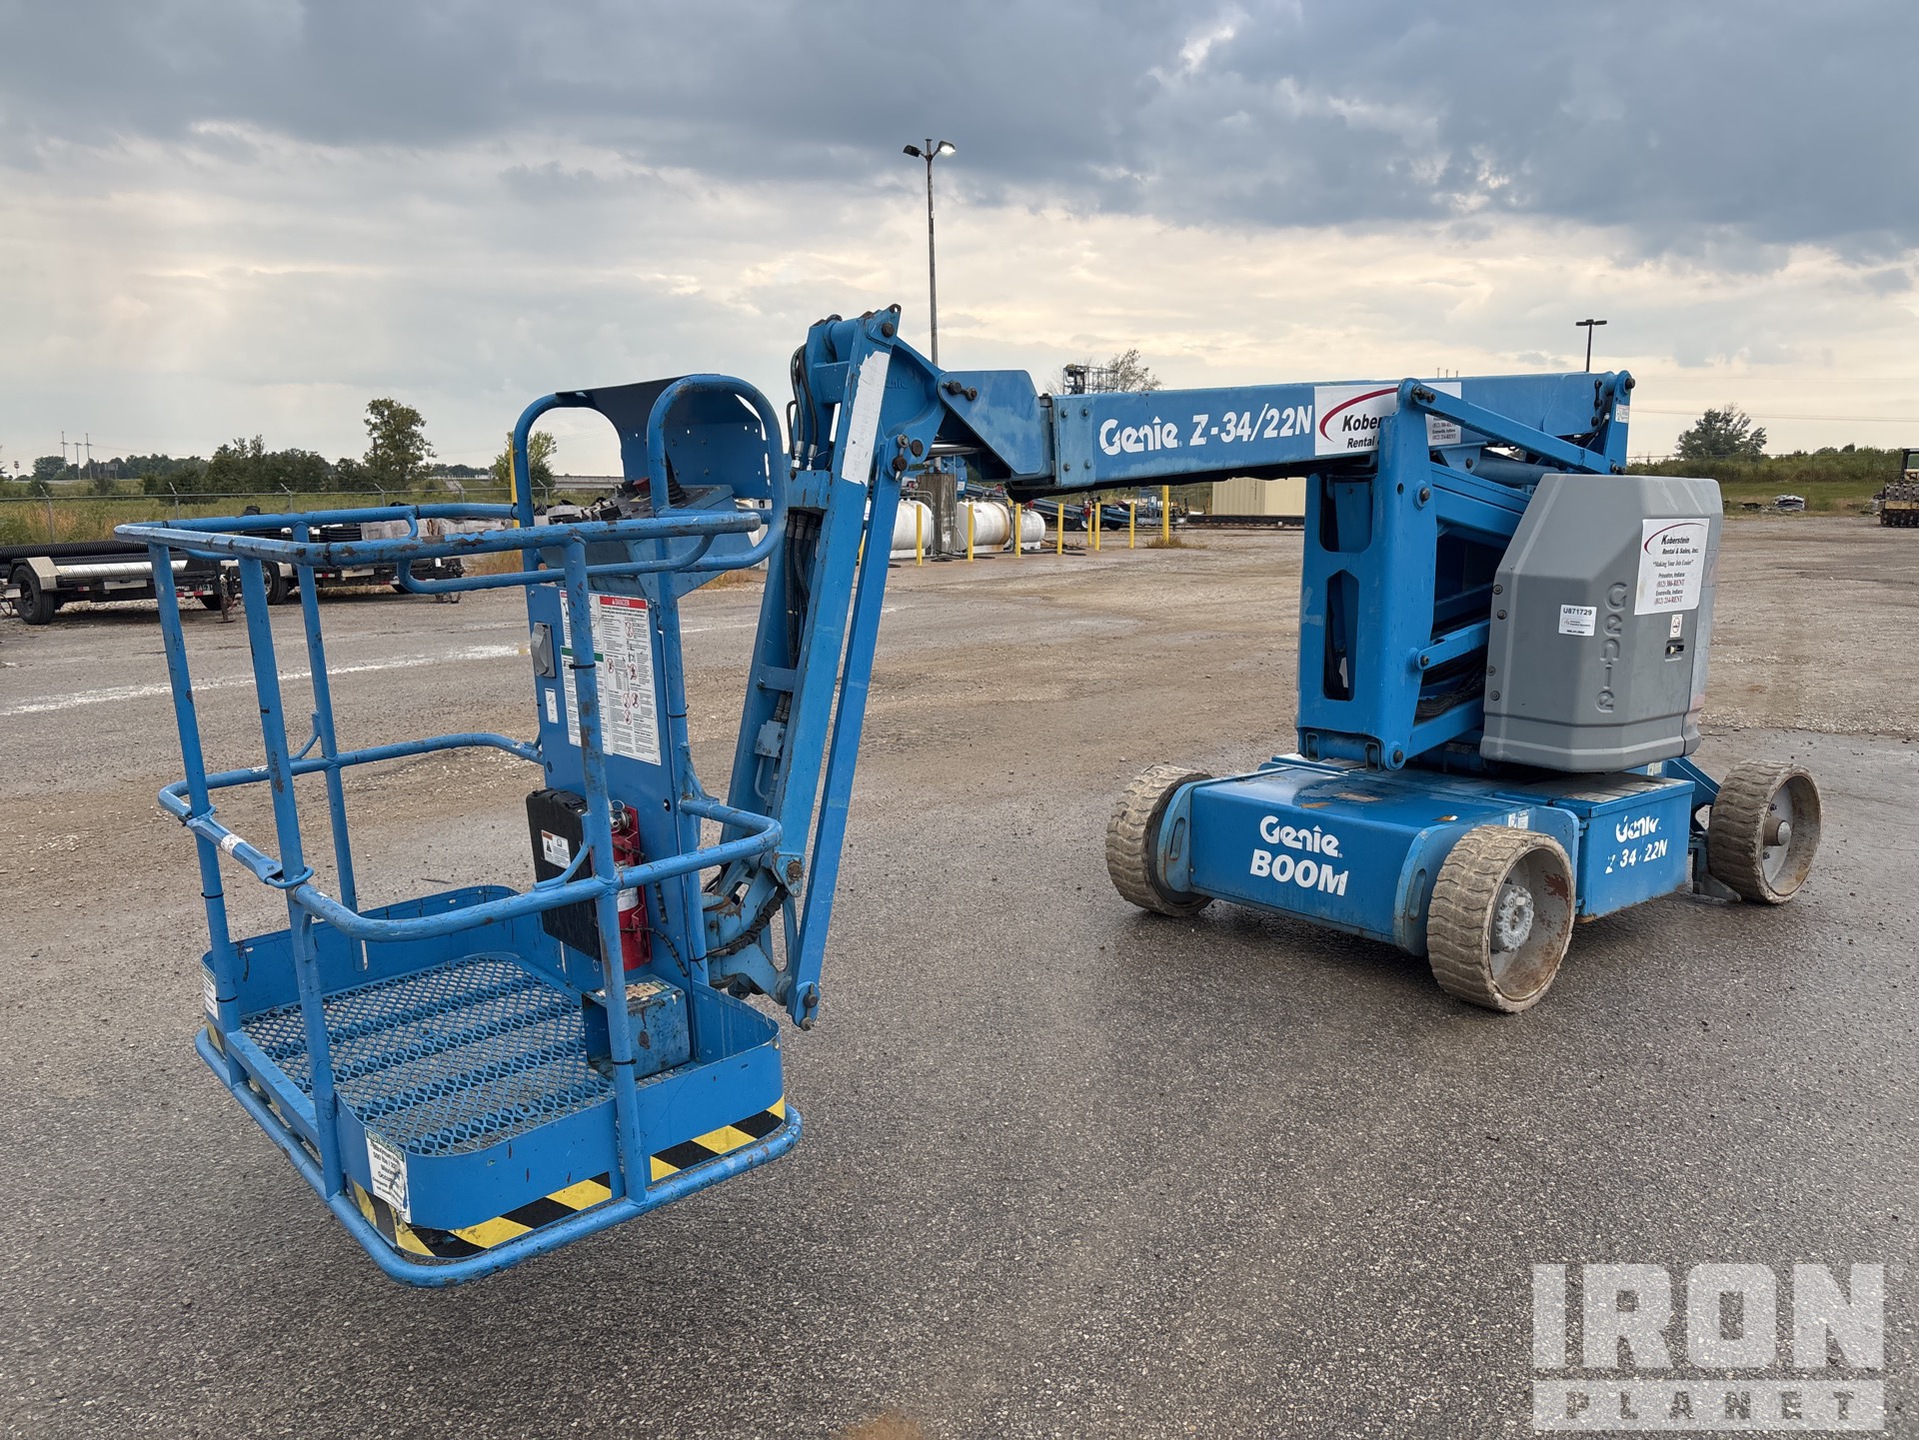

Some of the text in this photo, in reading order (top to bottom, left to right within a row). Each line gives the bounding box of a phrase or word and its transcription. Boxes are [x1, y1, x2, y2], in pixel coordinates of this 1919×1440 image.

[1099, 403, 1313, 456] Genie Z-34/22N
[1347, 436, 1375, 448] Rental
[1661, 535, 1689, 545] Koberstein
[1563, 608, 1592, 616] U871729
[1596, 582, 1627, 713] Genie
[1260, 815, 1339, 857] Genie
[1250, 849, 1349, 896] BOOM
